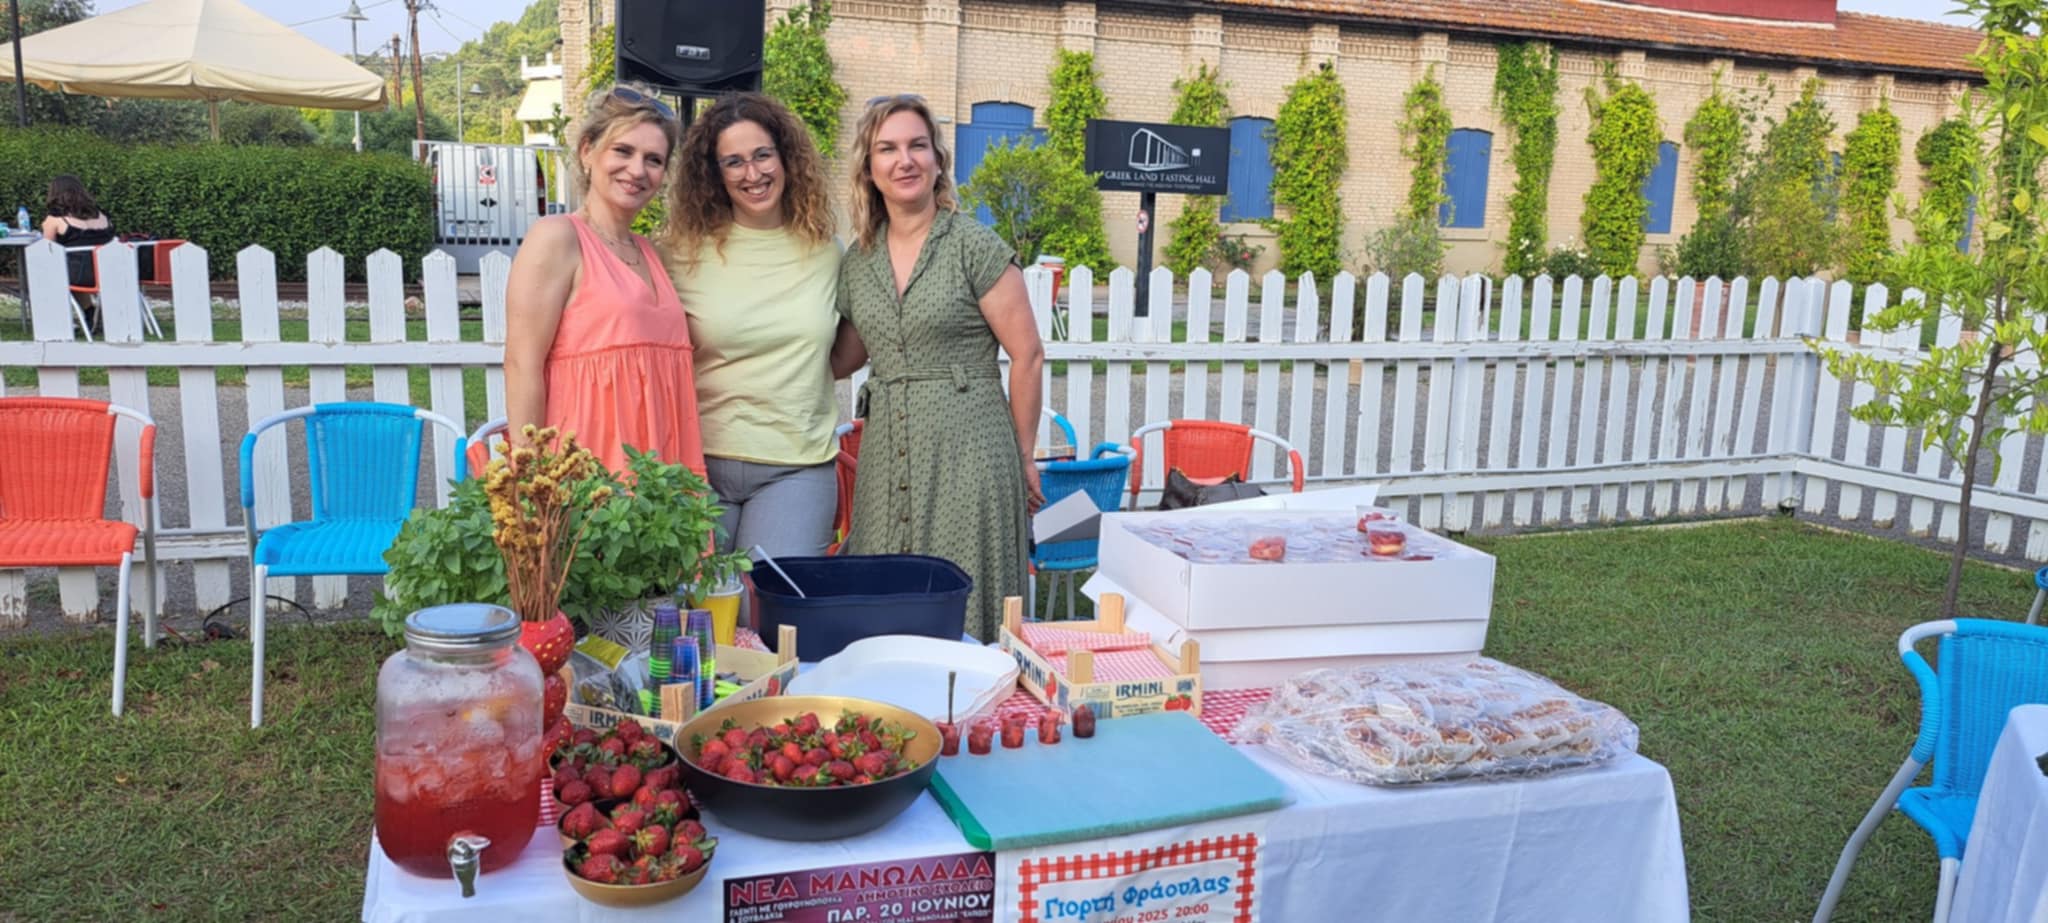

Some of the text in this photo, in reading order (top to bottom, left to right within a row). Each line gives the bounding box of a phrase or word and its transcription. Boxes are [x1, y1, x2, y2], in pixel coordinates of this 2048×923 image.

[1104, 170, 1216, 184] GREEK LAND TASTING HALL
[730, 876, 799, 907] ΝΕΑ
[1044, 875, 1232, 920] Γιορτή Φράουλας
[827, 894, 991, 923] ΠΑΡ. 20 ΙΟΥΝΙΟΥ
[1138, 909, 1169, 923] 2025
[1175, 903, 1209, 918] 20:00
